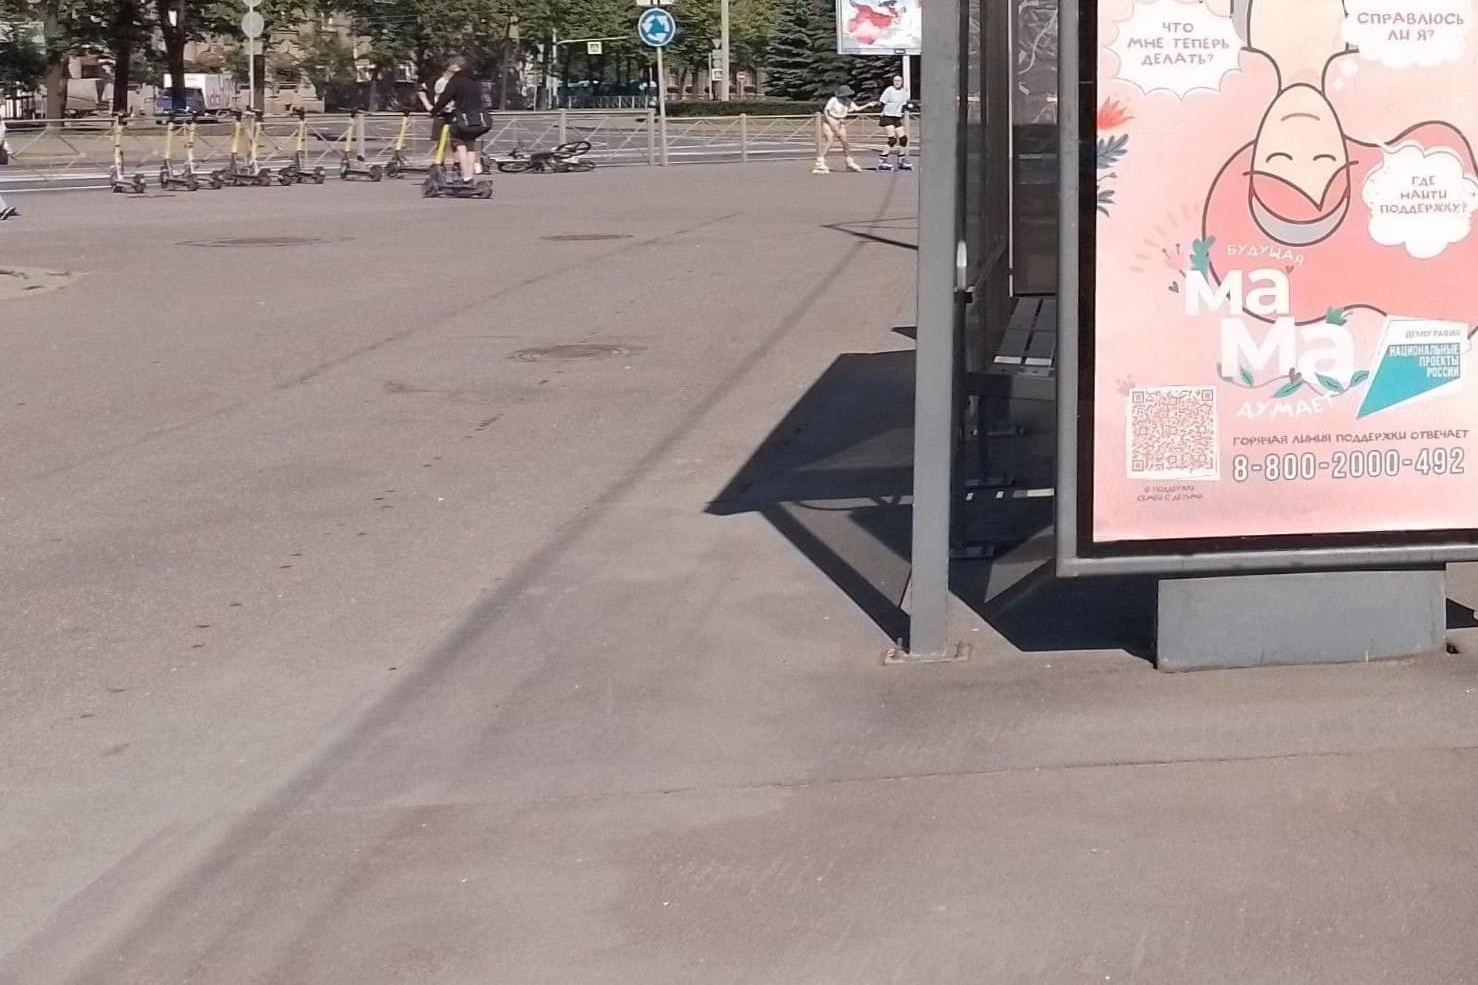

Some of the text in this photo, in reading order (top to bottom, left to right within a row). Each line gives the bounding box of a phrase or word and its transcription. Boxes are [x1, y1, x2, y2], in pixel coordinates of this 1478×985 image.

[1357, 12, 1465, 25] СПРАВЛЮСЬ
[1162, 22, 1195, 33] ЧТО
[1387, 29, 1435, 41] ЛИ Я?
[1127, 37, 1230, 49] МНЕ ТЕПЕРЬ
[1141, 53, 1215, 66] ДЕЛАТЬ?
[1411, 175, 1437, 187] ГДЕ
[1380, 201, 1468, 214] ПОДДЕРЖКУ?
[1227, 244, 1305, 266] БУДУЩАЯ
[1389, 344, 1460, 357] НАЦИОНАЛЬНЫЕ
[1419, 355, 1459, 367] ПРОЕКТЫ
[1427, 366, 1460, 377] РОССИИ
[1232, 429, 1470, 446] ГОРЯЧАЯ ЛИНИЯ ПОДДЕРЖКИ ОТВЕЧАЕТ
[1232, 446, 1466, 483] 8-800-2000-492
